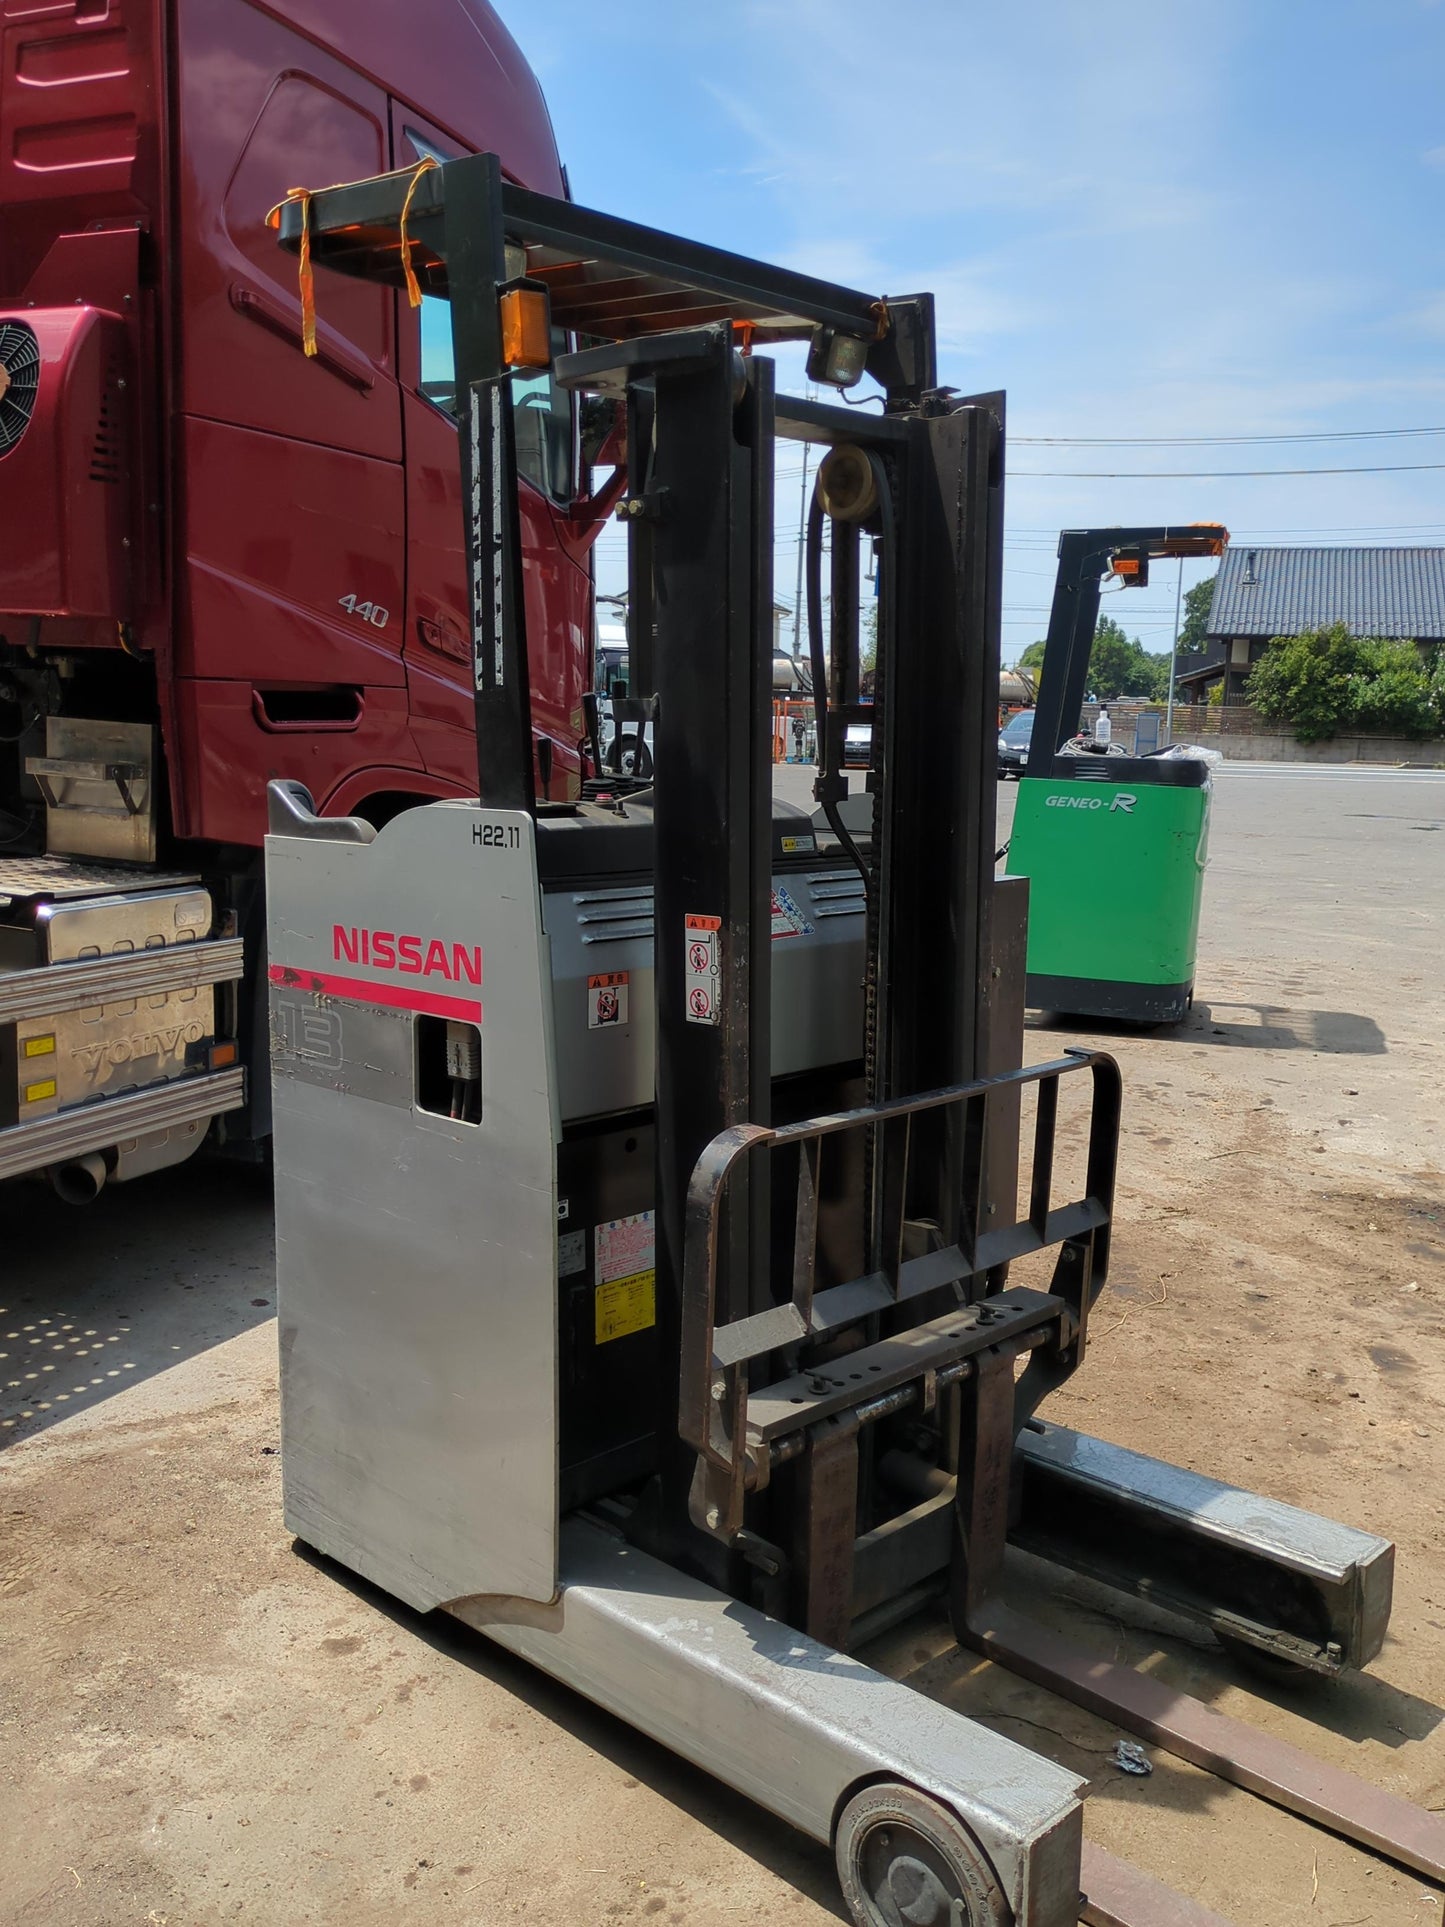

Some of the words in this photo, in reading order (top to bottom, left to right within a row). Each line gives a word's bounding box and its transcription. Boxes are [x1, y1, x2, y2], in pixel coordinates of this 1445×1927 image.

[338, 594, 389, 628] 440
[1045, 793, 1137, 814] GENEO-R
[472, 823, 520, 849] H22.11
[332, 924, 482, 985] NISSAN
[71, 1020, 206, 1074] VOLVO
